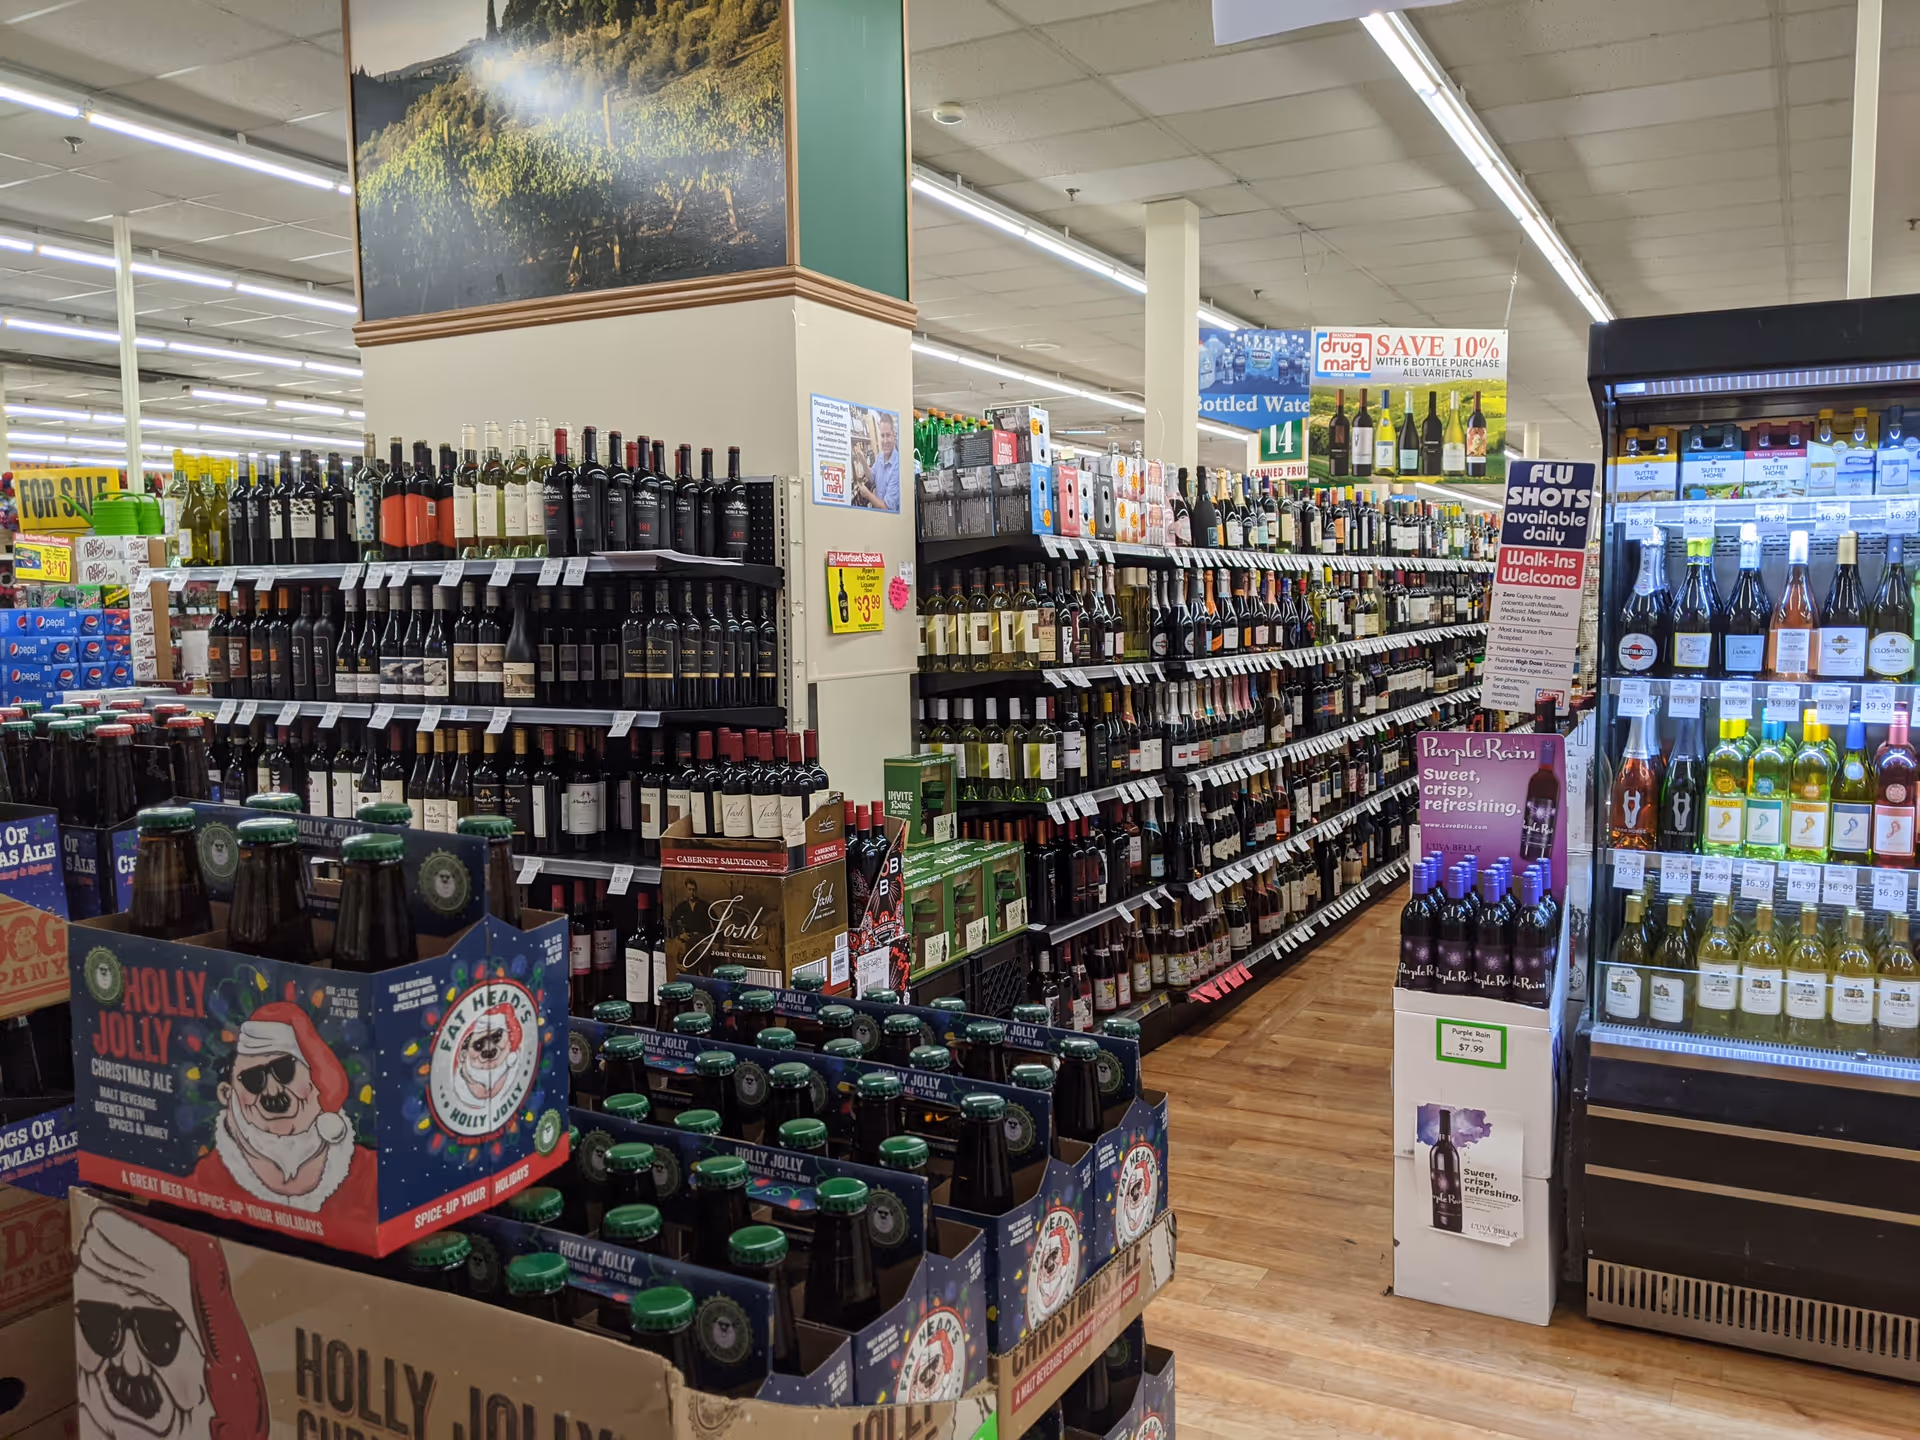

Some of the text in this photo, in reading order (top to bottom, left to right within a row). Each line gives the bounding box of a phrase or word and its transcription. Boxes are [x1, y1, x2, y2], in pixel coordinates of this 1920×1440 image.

[1320, 338, 1363, 357] drug
[1376, 335, 1500, 359] SAVE 10%
[1323, 354, 1372, 371] mart
[1375, 357, 1500, 368] WITH 6 BOTTLE PURCHASE
[1402, 368, 1473, 378] ALL VARIETALS
[1263, 396, 1310, 413] Wate
[1268, 420, 1294, 454] 14
[999, 442, 1012, 456] LONG
[824, 470, 840, 485] drug
[1250, 467, 1284, 478] CANNED
[1530, 464, 1574, 484] FLU
[19, 478, 58, 519] FOR
[1508, 486, 1591, 509] SHOTS
[1506, 511, 1587, 527] available
[1630, 518, 1654, 526] $6.99
[1760, 514, 1784, 522] $6.99
[1820, 512, 1846, 521] $6.99
[1890, 510, 1916, 519] $6.99
[1523, 526, 1566, 546] daily
[1506, 550, 1577, 569] Walk-Ins
[1502, 567, 1577, 586] Welcome
[46, 617, 65, 628] pepsi
[18, 645, 37, 655] pepsi
[21, 671, 41, 682] pepsi
[1771, 700, 1796, 708] $9.99
[1866, 702, 1892, 710] $9.99
[1421, 736, 1536, 766] Purple Rain
[1424, 768, 1480, 784] Sweet,
[888, 790, 913, 801] INVITE
[1424, 782, 1473, 799] crisp,
[726, 802, 744, 822] Josh
[1424, 798, 1522, 816] refreshing.
[22, 842, 56, 863] ALE
[814, 851, 838, 862] SAUVIGNON
[815, 845, 837, 856] CABERNET
[676, 855, 768, 867] CABERNET SAUVIGNON
[1618, 868, 1640, 876] $9.99
[1666, 872, 1688, 880] $9.99
[1704, 872, 1728, 882] $6.99
[1746, 879, 1770, 888] $6.99
[1792, 880, 1816, 889] $6.99
[1828, 884, 1854, 892] $6.99
[1878, 888, 1904, 898] $6.99
[801, 879, 834, 933] Josh
[682, 894, 764, 968] Josh
[711, 950, 767, 962] JOSH CELLARS
[122, 965, 207, 1018] HOLLY
[783, 992, 808, 1006] JOLLY
[440, 1012, 466, 1052] FAT
[472, 990, 532, 1025] HEAD'S
[92, 1010, 172, 1065] JOLLY
[1010, 1024, 1038, 1040] JOLLY
[1452, 1028, 1490, 1038] Purple Rain
[664, 1036, 689, 1050] JOLLY
[1458, 1042, 1484, 1054] $7.99
[653, 1048, 665, 1056] ALE
[91, 1058, 174, 1094] CHRISTMAS ALE
[910, 1074, 940, 1090] JOLLY
[100, 1086, 158, 1110] MALT BEVERAGE
[904, 1086, 914, 1094] ALE
[94, 1100, 146, 1122] BREWED WITH
[450, 1107, 487, 1128] HOLLY
[493, 1082, 523, 1122] JOLLY
[108, 1118, 168, 1140] SPICES HONEY
[735, 1146, 804, 1172] HOLLY JOLLY
[1129, 1150, 1156, 1175] HEAD'S
[763, 1167, 776, 1177] ALE
[1464, 1168, 1498, 1181] Sweet,
[1464, 1176, 1494, 1190] crisp,
[415, 1164, 529, 1229] SPICE-UP YOUR HOLIDAYS
[1464, 1186, 1521, 1202] refreshing.
[122, 1169, 324, 1236] A GREAT BEER TO SPICE-UP YOUR HOLIDAYS
[1044, 1216, 1076, 1242] HEAD'S
[559, 1240, 636, 1274] HOLLY JOLLY
[588, 1266, 604, 1280] ALE
[900, 1317, 960, 1392] FAT HEAD'S
[296, 1327, 436, 1440] HOLLY
[1021, 1378, 1036, 1402] MALT
[1036, 1354, 1063, 1387] BEVERAGE
